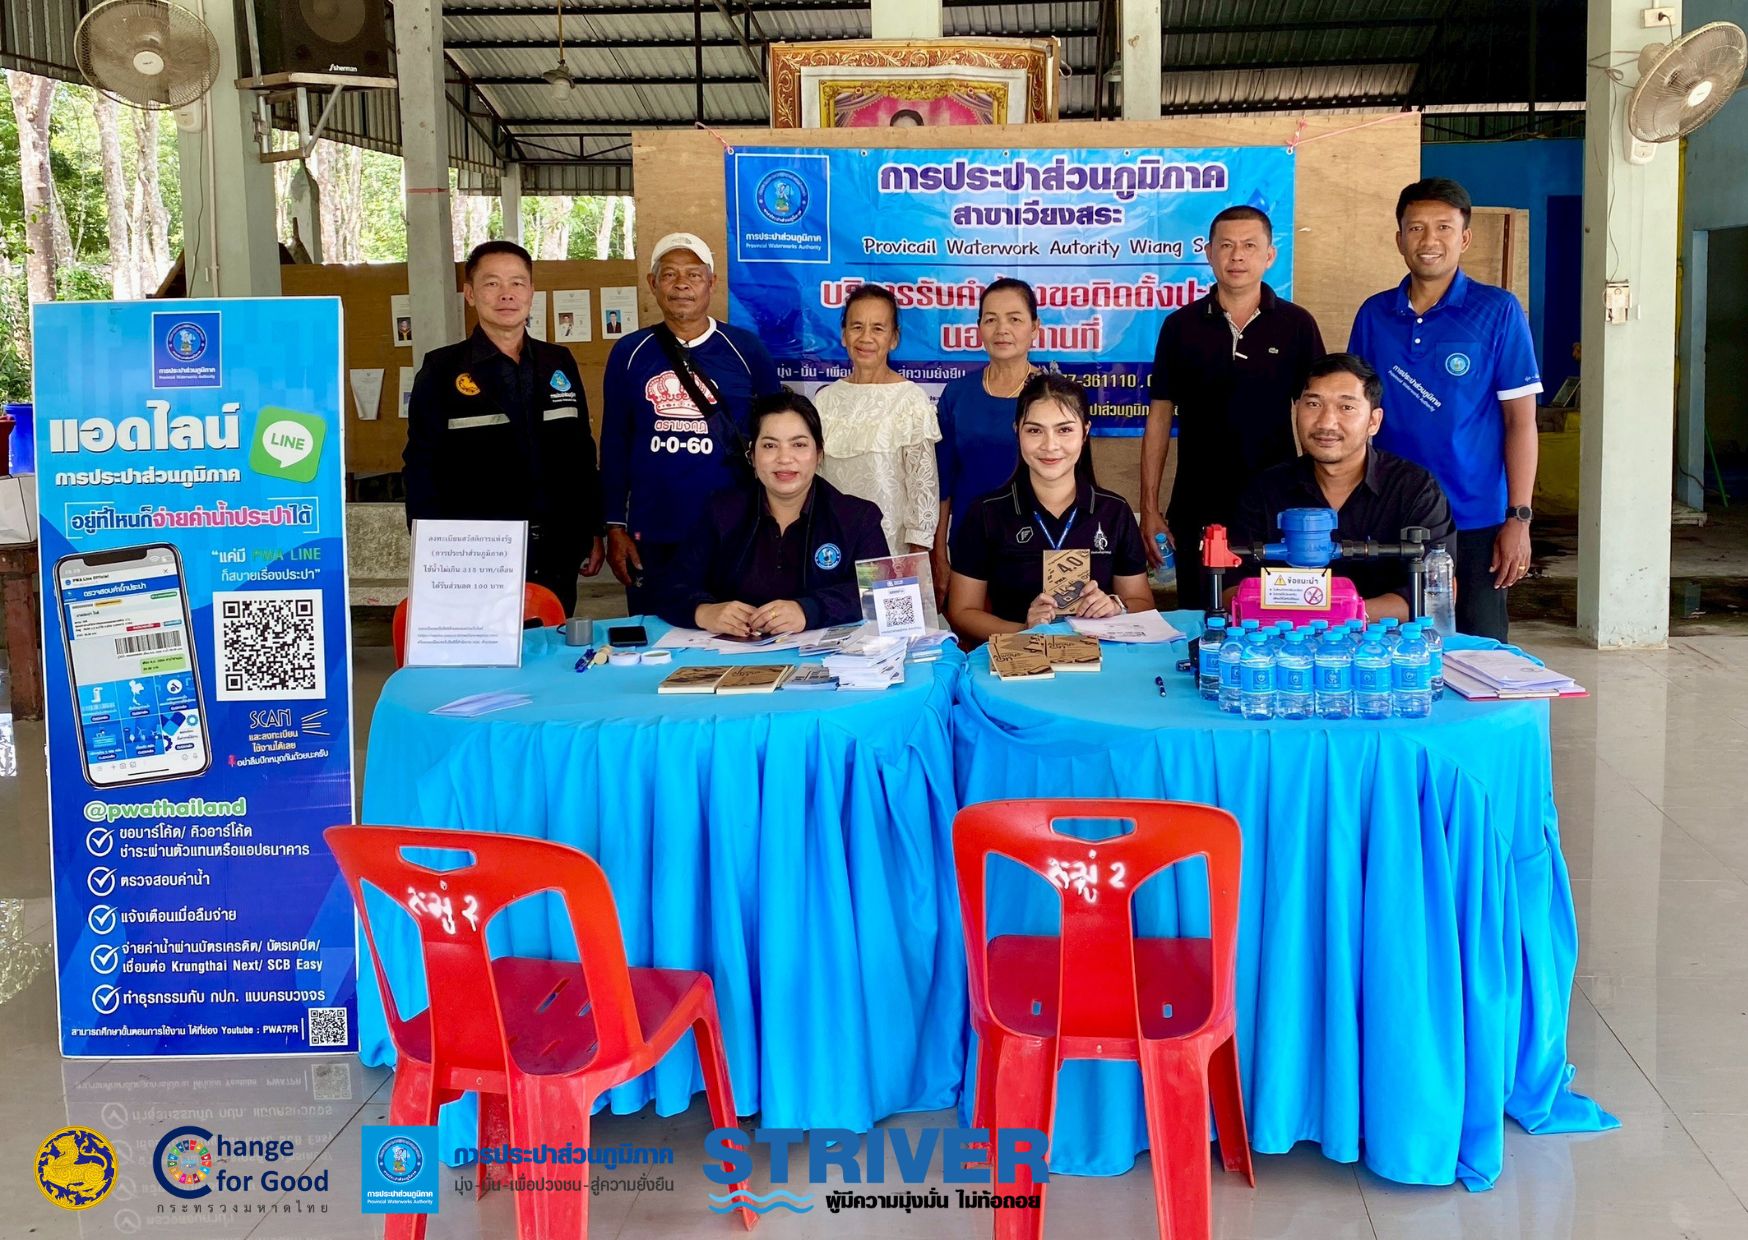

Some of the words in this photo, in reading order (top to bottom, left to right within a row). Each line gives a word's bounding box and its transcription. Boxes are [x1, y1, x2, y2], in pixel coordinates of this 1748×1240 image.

[880, 157, 1226, 200] การประปาส่วนภูมิภาค
[953, 200, 1122, 226] สาขาเวียงสระ
[745, 232, 822, 244] การประปาส่วนภูมิภาค
[864, 238, 936, 255] Provicail
[947, 239, 1040, 255] Waterwork
[1050, 240, 1120, 257] Autority
[1130, 239, 1182, 257] Wiang
[50, 400, 240, 453] แอดไลน์
[271, 432, 306, 451] LINE
[650, 436, 713, 454] 0-0-60
[55, 466, 241, 490] การประปาส่วนภูมิภาค
[72, 501, 311, 534] อยู่ที่ไหนก็จ่ายค่าน้ำประปาได้
[252, 548, 284, 561] PWA
[290, 548, 321, 560] LINE
[250, 708, 292, 729] SCAN
[83, 797, 246, 823] @pwathailand
[119, 823, 186, 840] ขอบาร์โค้ด/
[190, 822, 252, 839] คิวอาร์โค้ด
[120, 842, 310, 858] ชำระผ่านตัวแทนหรือแอปธนาคาร
[120, 869, 210, 887] ตรวจสอบค่าน้ำ
[1108, 862, 1126, 889] 2
[121, 908, 237, 924] แจ้งเตือนเมื่อลืมจ่าย
[462, 894, 479, 932] 2
[121, 938, 262, 955] จ่ายค่าน้ำผ่านบัตรเครดิต/
[267, 939, 320, 953] บัตรเดบิต/
[123, 960, 166, 973] เชื่อมต่อ
[172, 959, 227, 974] Krungthai
[233, 959, 263, 972] Next/
[267, 959, 291, 971] SCB
[297, 959, 322, 972] Easy
[123, 988, 205, 1008] ทำธุรกรรมกับ
[211, 989, 239, 1003] กปภ.
[245, 989, 325, 1002] แบบครบวงจร
[221, 1025, 253, 1035] Youtube
[263, 1025, 299, 1035] PWA7PR
